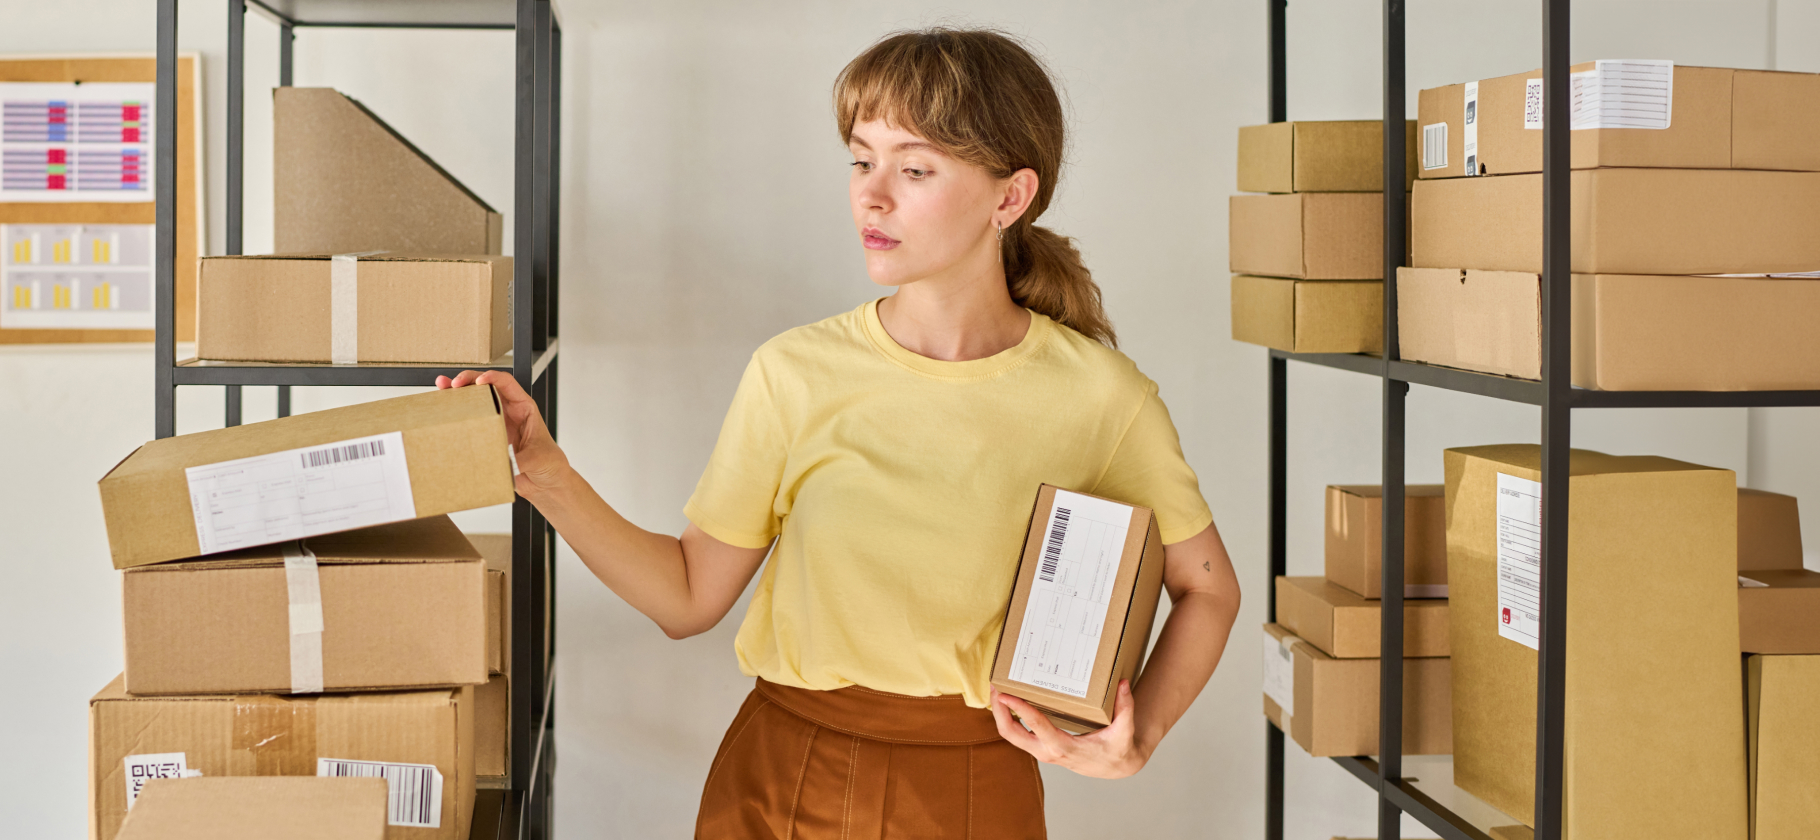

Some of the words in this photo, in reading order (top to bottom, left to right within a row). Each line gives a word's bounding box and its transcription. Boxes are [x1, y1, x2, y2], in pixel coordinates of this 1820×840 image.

[198, 525, 208, 552] EXPRESS
[1032, 679, 1059, 690] DELIVERY
[1061, 685, 1086, 696] EXPRESS
